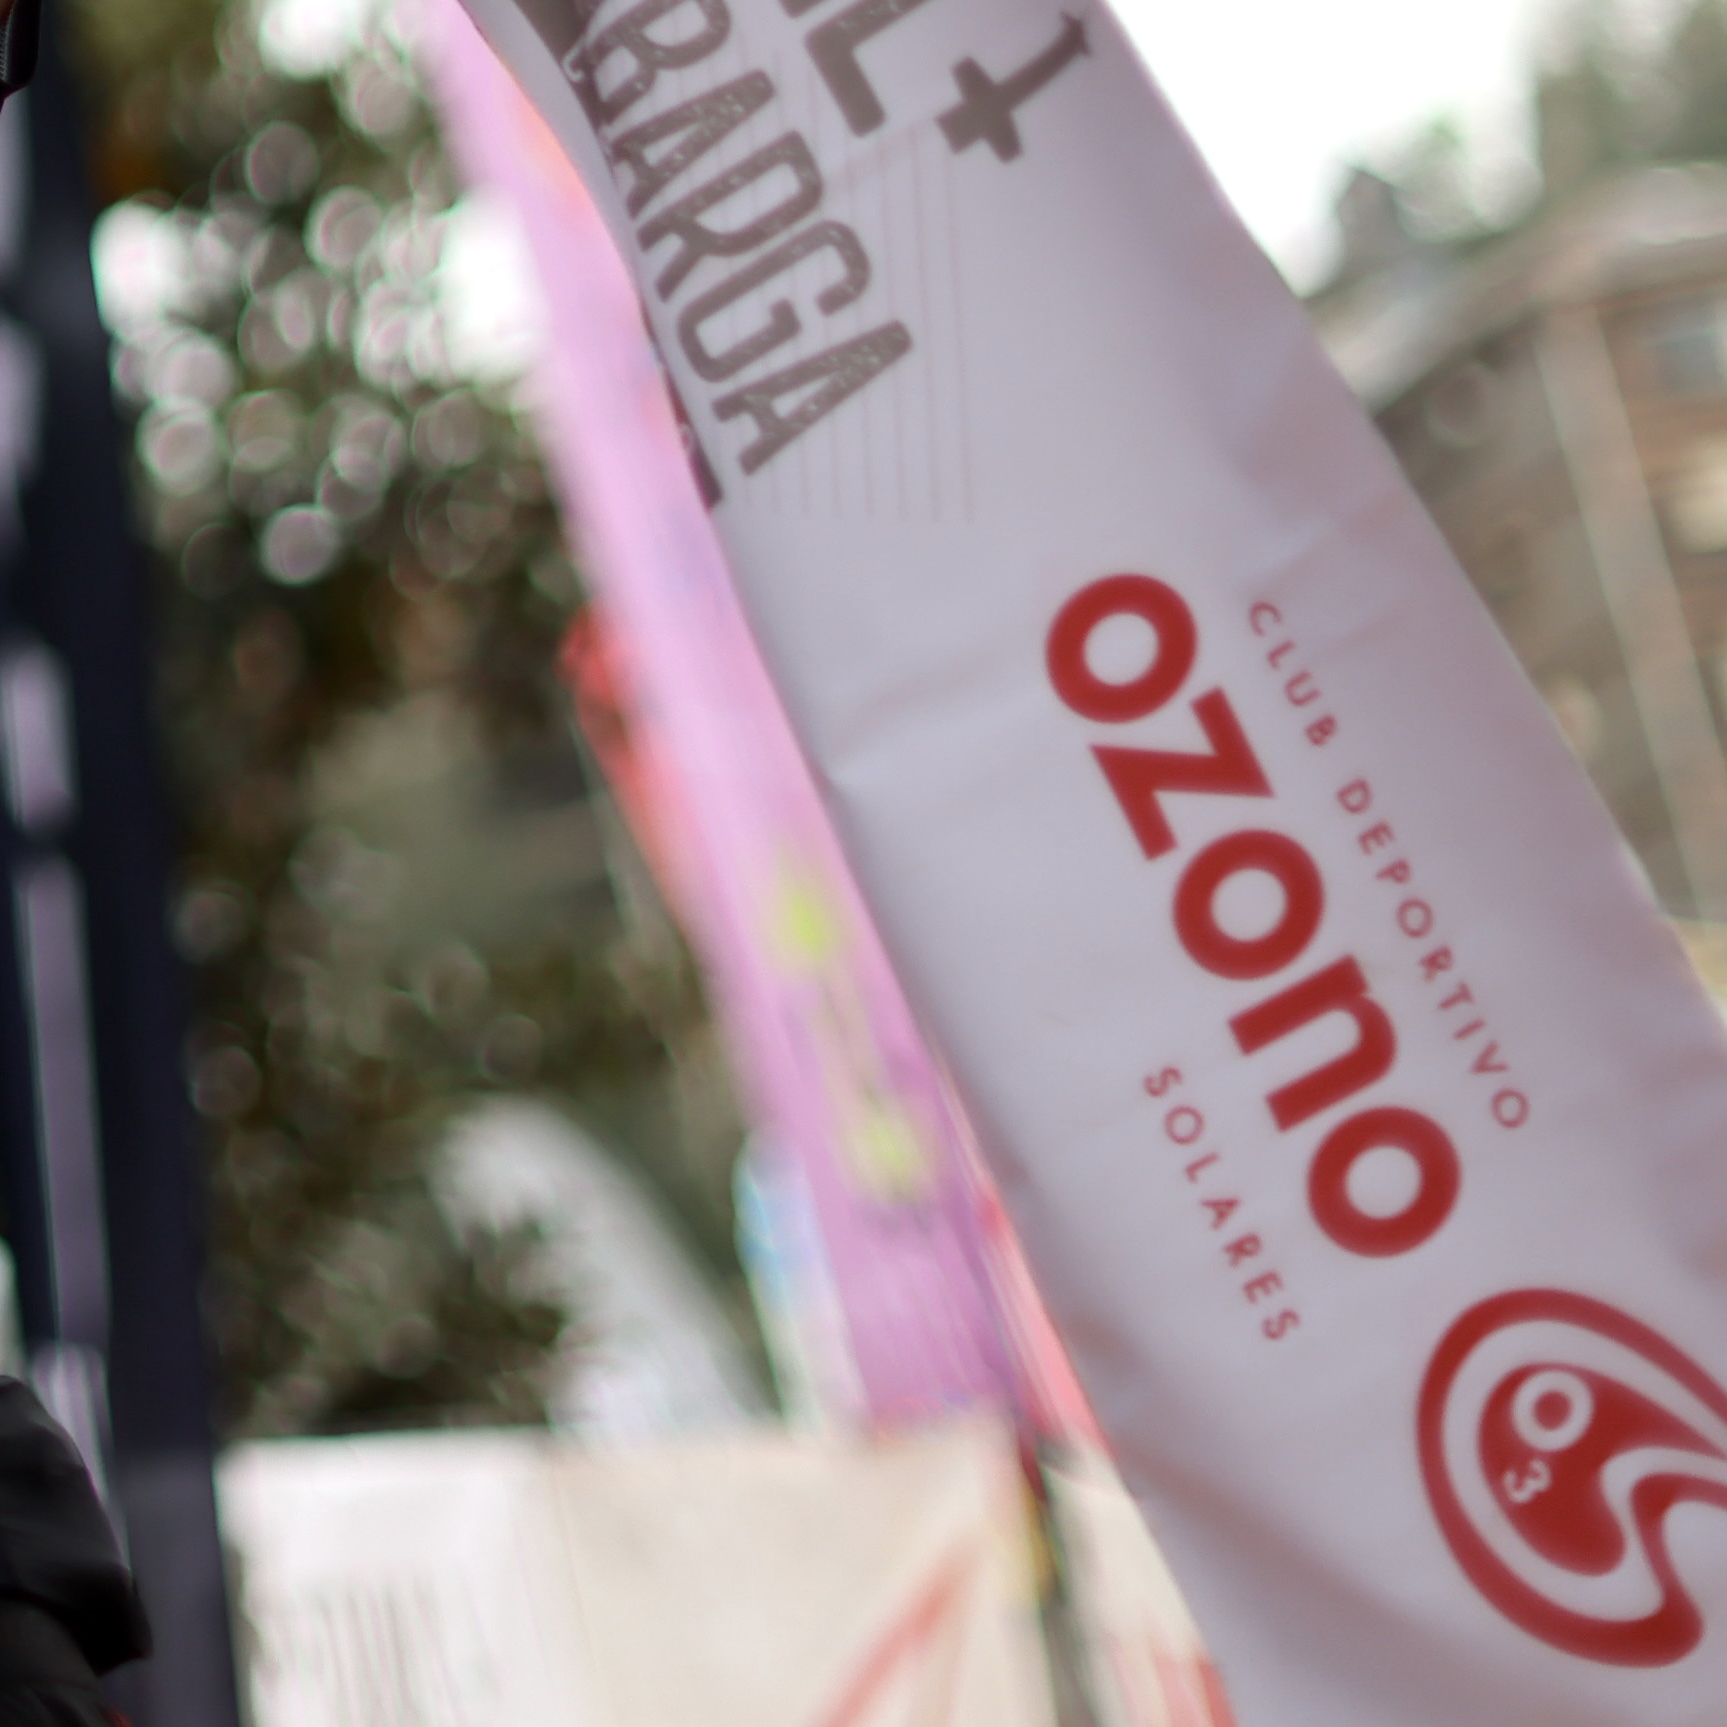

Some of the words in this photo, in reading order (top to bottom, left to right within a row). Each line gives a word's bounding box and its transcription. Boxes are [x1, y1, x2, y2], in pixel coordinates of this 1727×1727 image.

[1045, 574, 1462, 1259] ozono
[1249, 600, 1340, 748] CLUB
[1336, 778, 1530, 1131] DEPORTIVO
[1143, 1064, 1301, 1344] SOLARES
